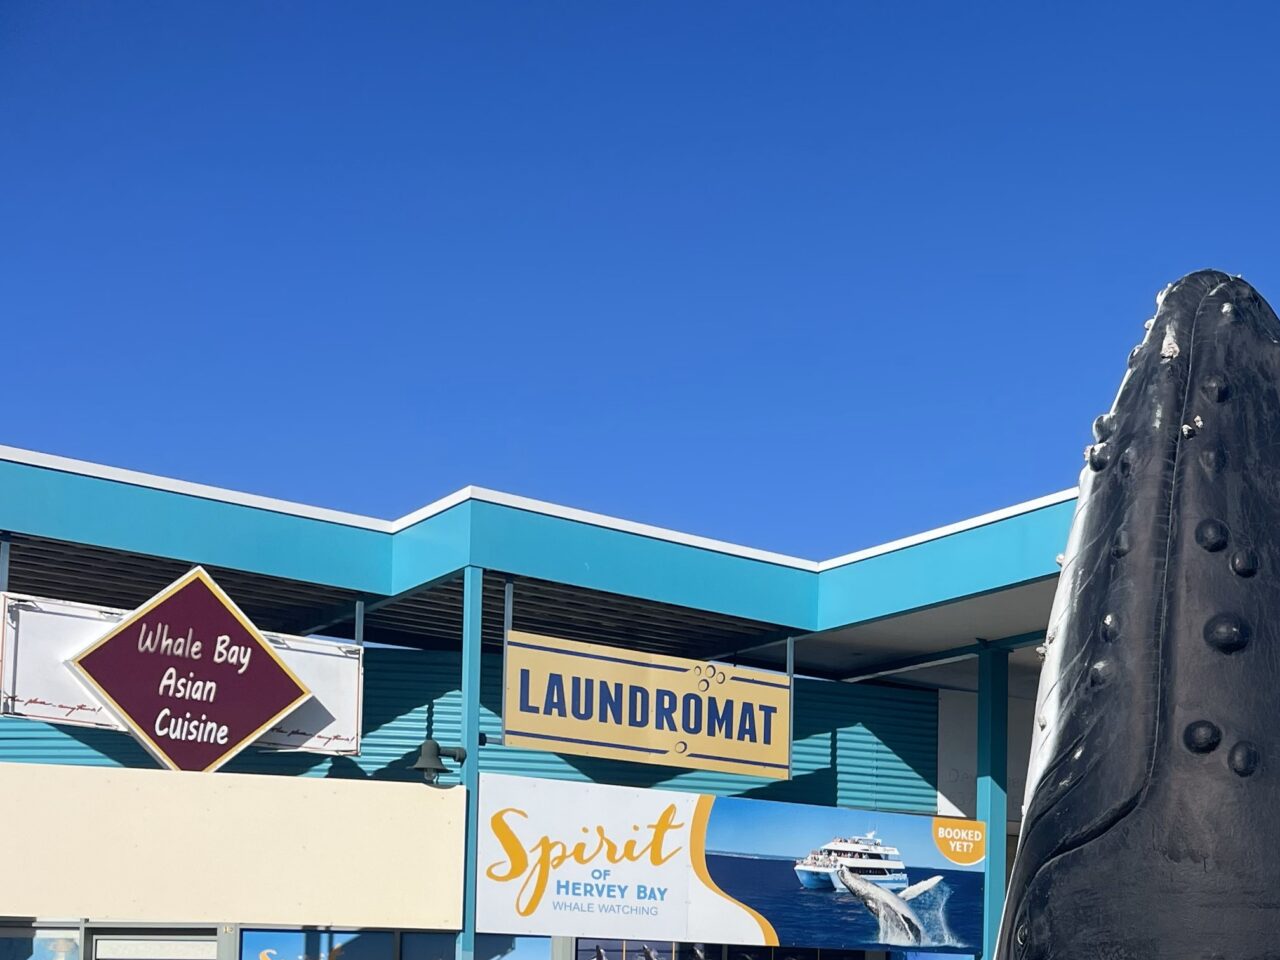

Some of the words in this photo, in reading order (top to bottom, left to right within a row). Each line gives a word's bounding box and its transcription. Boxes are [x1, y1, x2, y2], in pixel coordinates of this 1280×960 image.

[138, 622, 202, 659] Whale
[213, 635, 252, 674] Bay
[158, 667, 217, 703] Asian
[519, 668, 778, 746] LAUNDROMAT
[154, 708, 229, 745] Cuisine
[938, 827, 983, 842] BOOKED
[949, 840, 974, 853] YET?
[486, 803, 685, 918] Spirit
[591, 868, 611, 881] OF
[556, 880, 629, 899] HERVEY
[637, 885, 668, 901] BAY
[552, 901, 595, 913] WHALE
[598, 904, 659, 916] WATCHING
